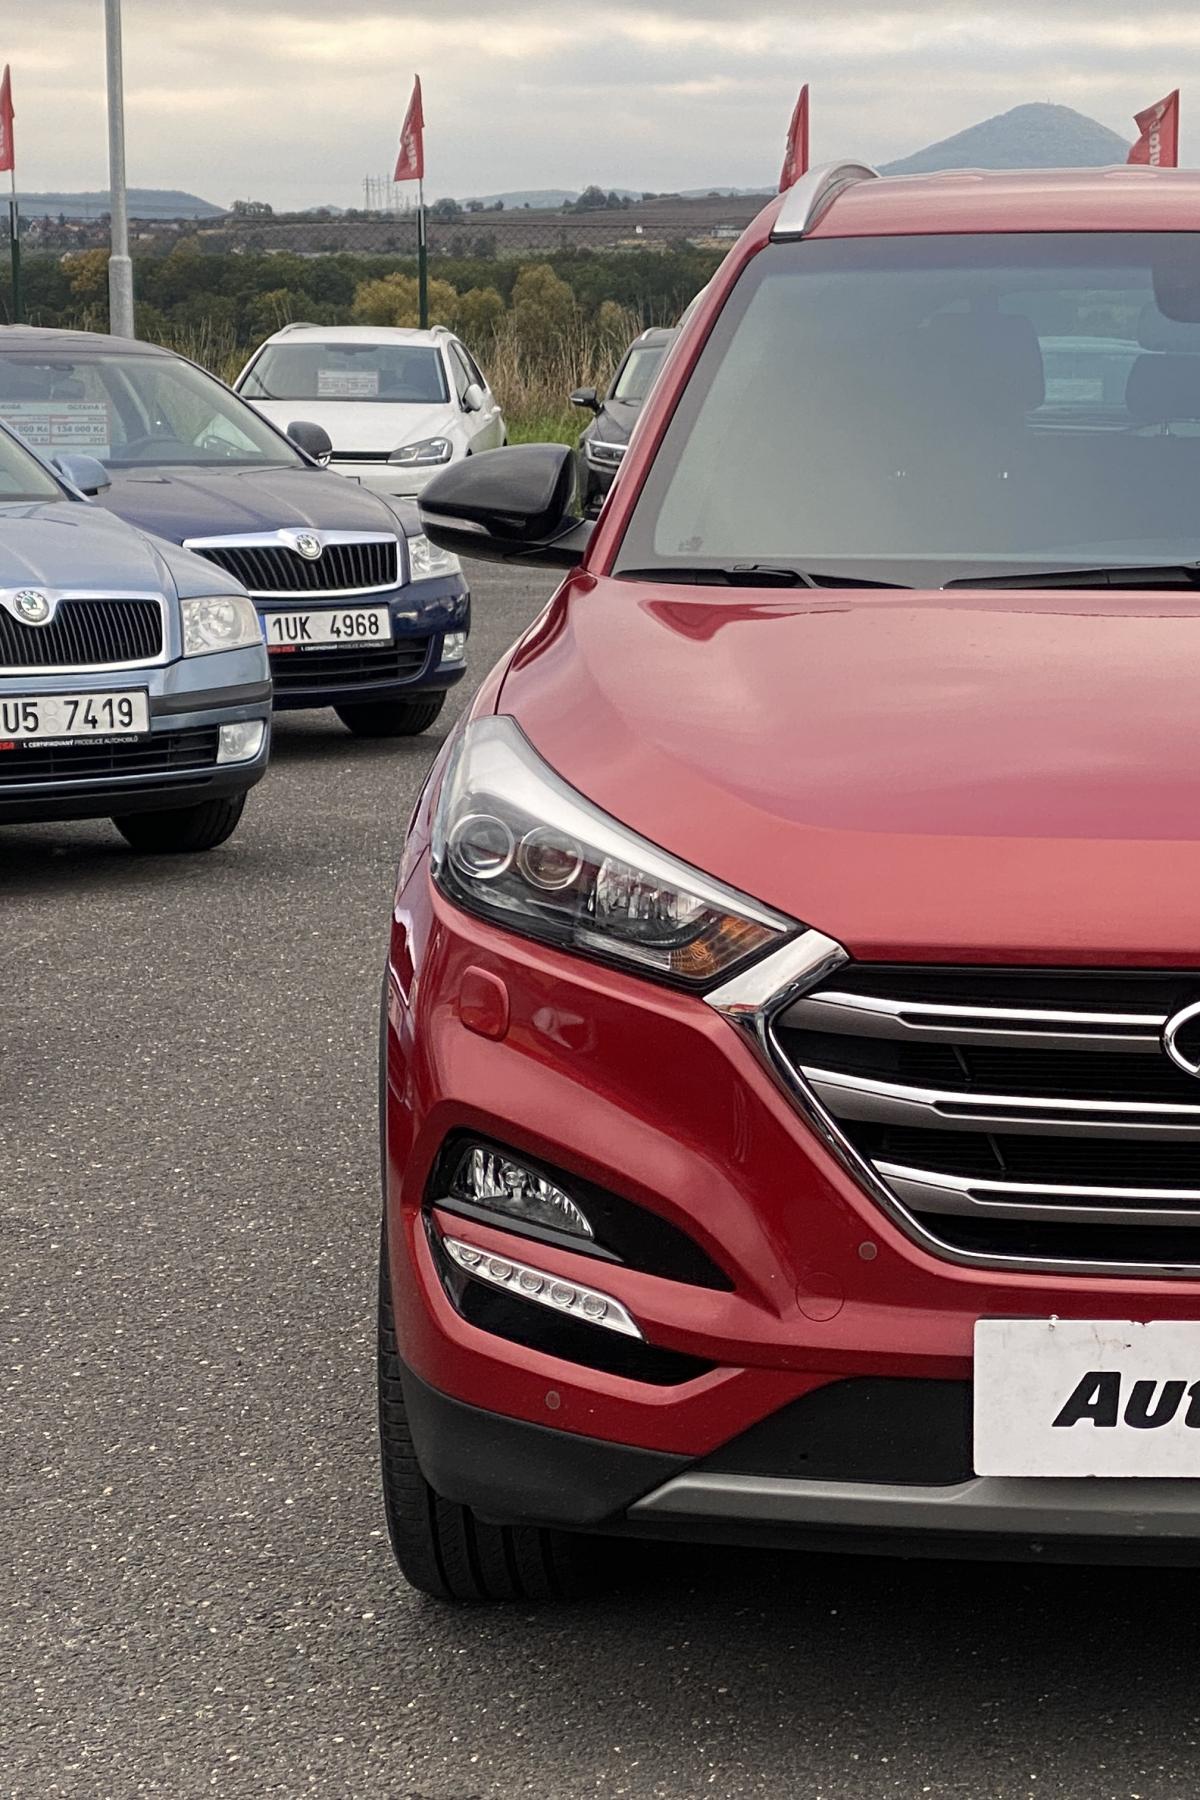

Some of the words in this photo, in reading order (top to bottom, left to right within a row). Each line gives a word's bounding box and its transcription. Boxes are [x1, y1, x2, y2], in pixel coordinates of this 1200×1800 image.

[272, 615, 312, 641] 1UK
[330, 612, 379, 638] 4968
[2, 702, 39, 733] U5
[63, 697, 133, 731] 7419
